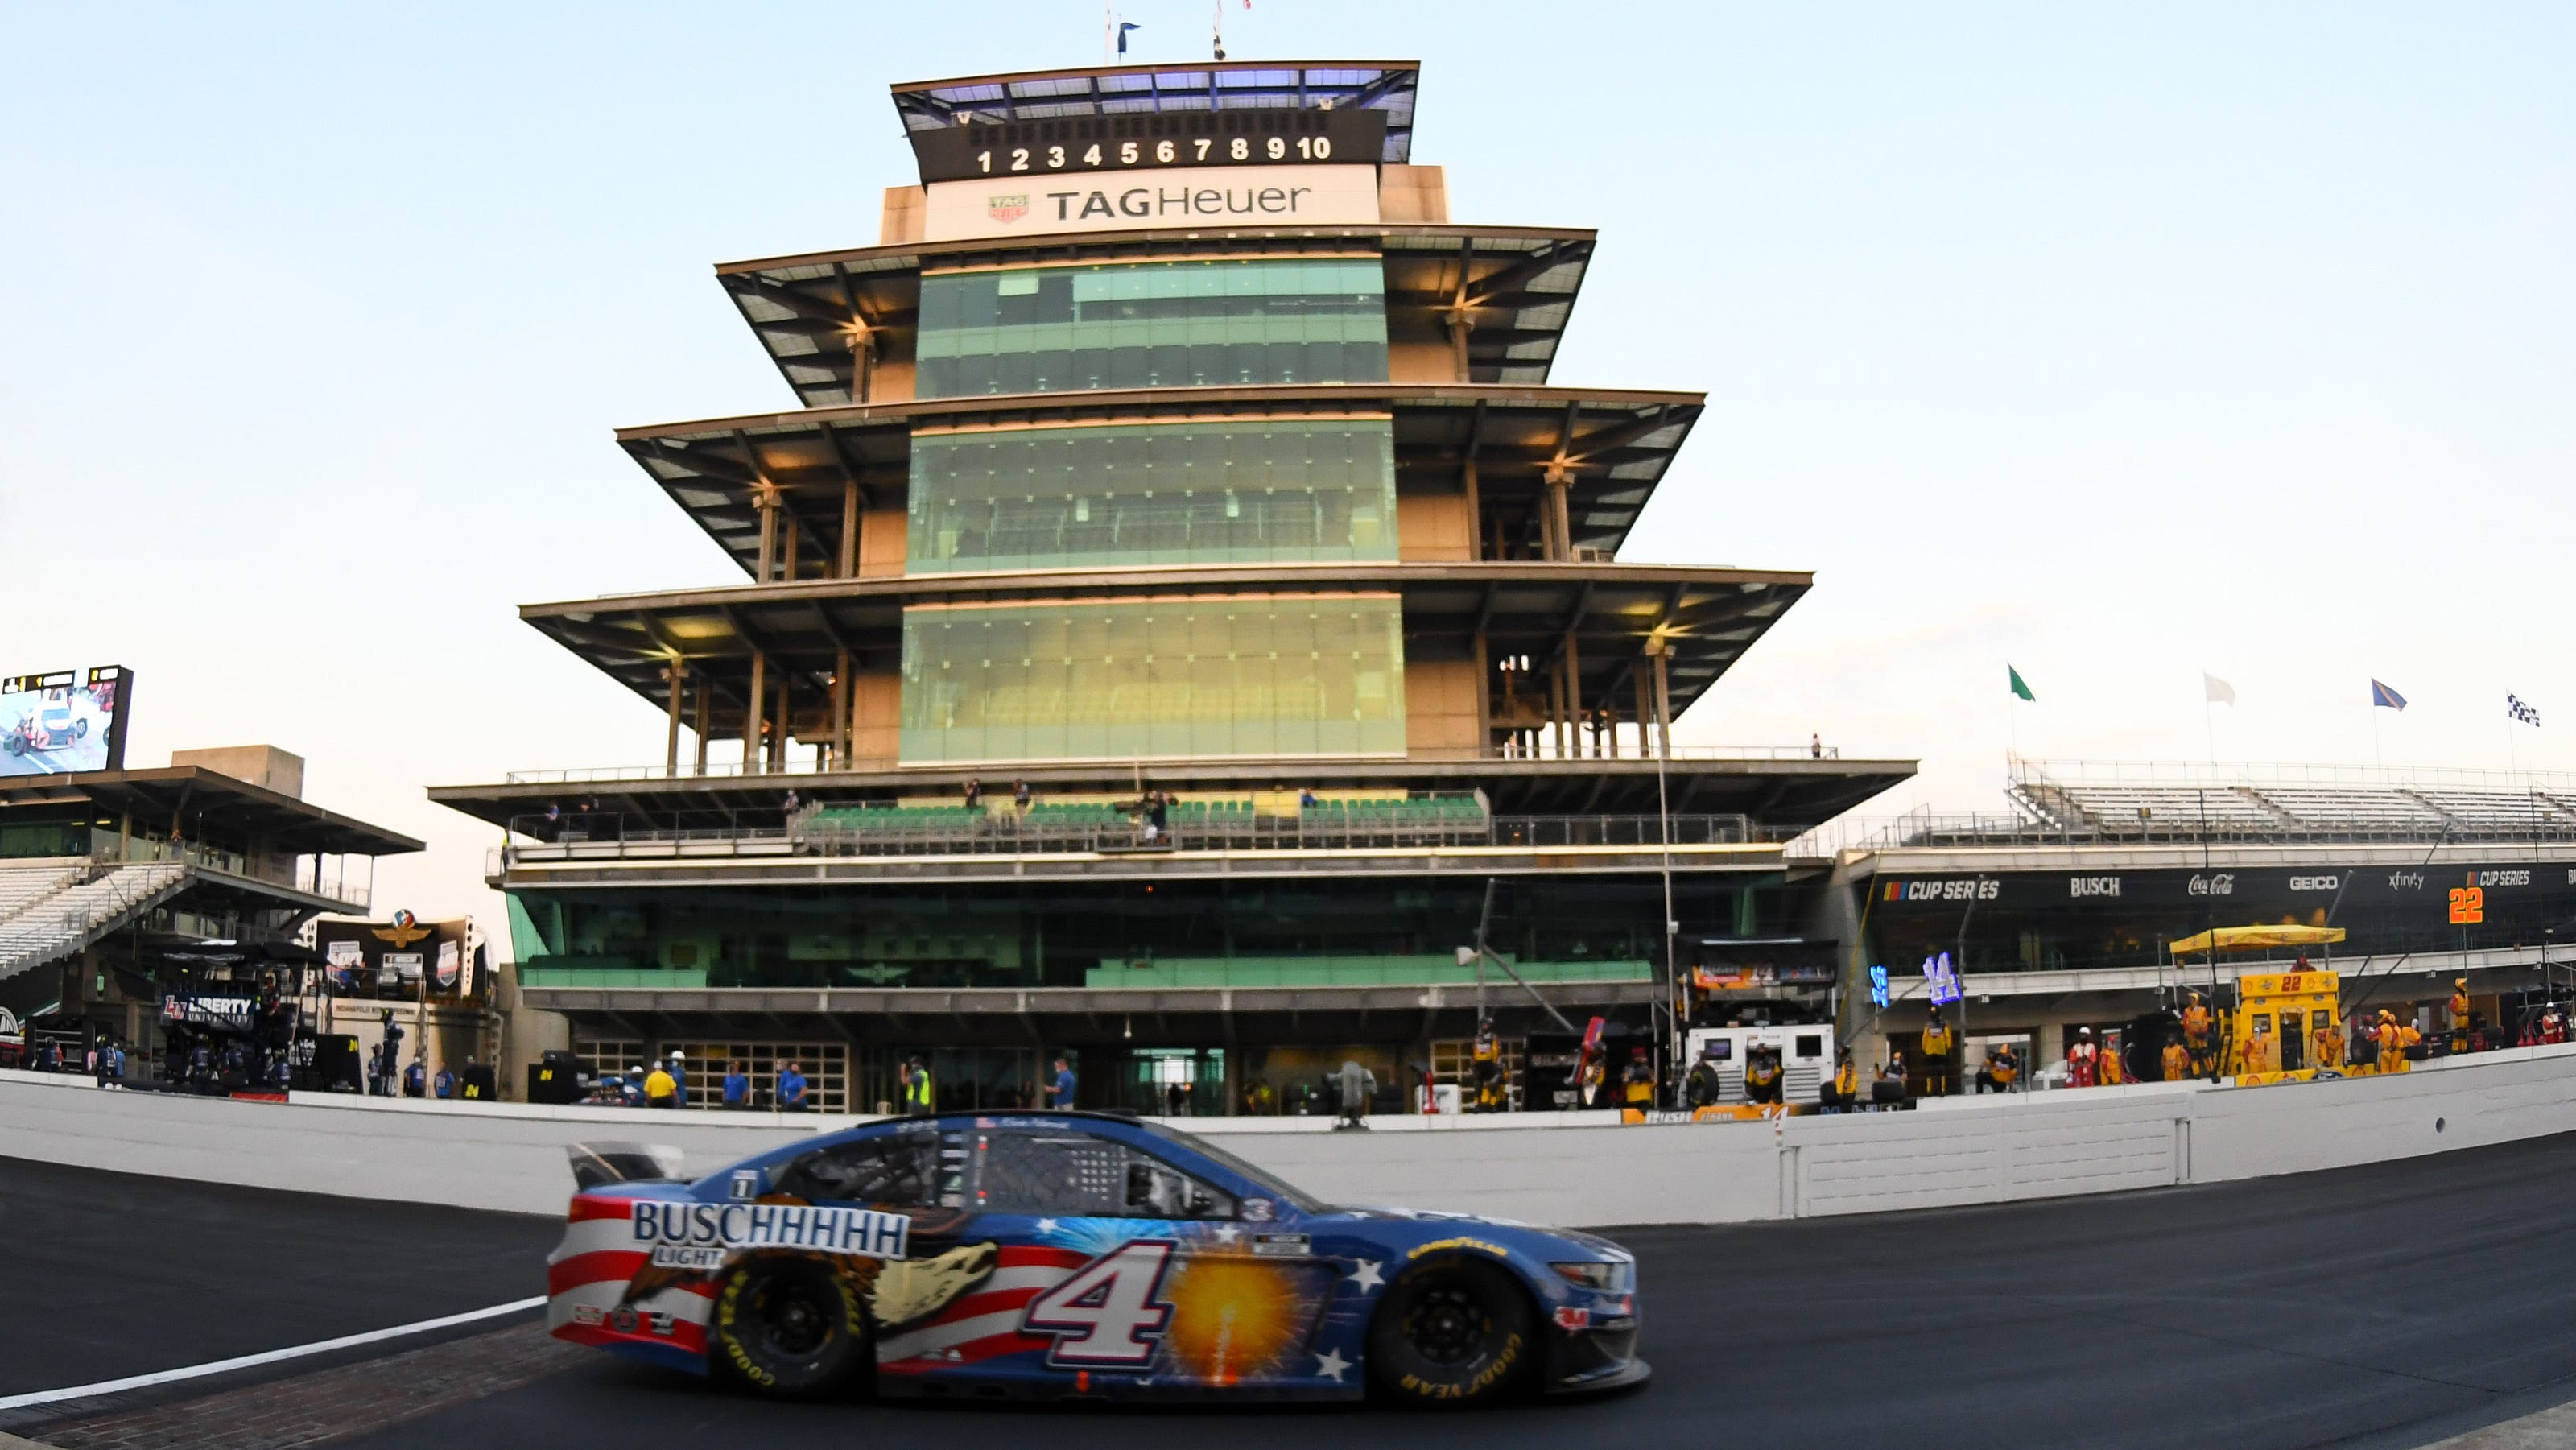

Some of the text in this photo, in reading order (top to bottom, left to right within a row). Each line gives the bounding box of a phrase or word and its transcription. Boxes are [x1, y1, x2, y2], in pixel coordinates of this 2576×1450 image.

[978, 136, 1331, 173] 1 2 3 4 5 6 7 8 9 10
[2070, 877, 2120, 897] BUSCH
[2289, 876, 2338, 890] GEICO
[2388, 871, 2424, 891] xfinity
[2479, 870, 2530, 886] CUP SERIES
[1908, 880, 2000, 900] CUP SERES
[2449, 887, 2483, 924] 22
[1922, 951, 1963, 1006] 14
[2281, 976, 2301, 993] 22
[634, 1202, 904, 1255] BUSCHHHHH
[657, 1248, 718, 1266] LIGHT
[1019, 1237, 1178, 1369] 4
